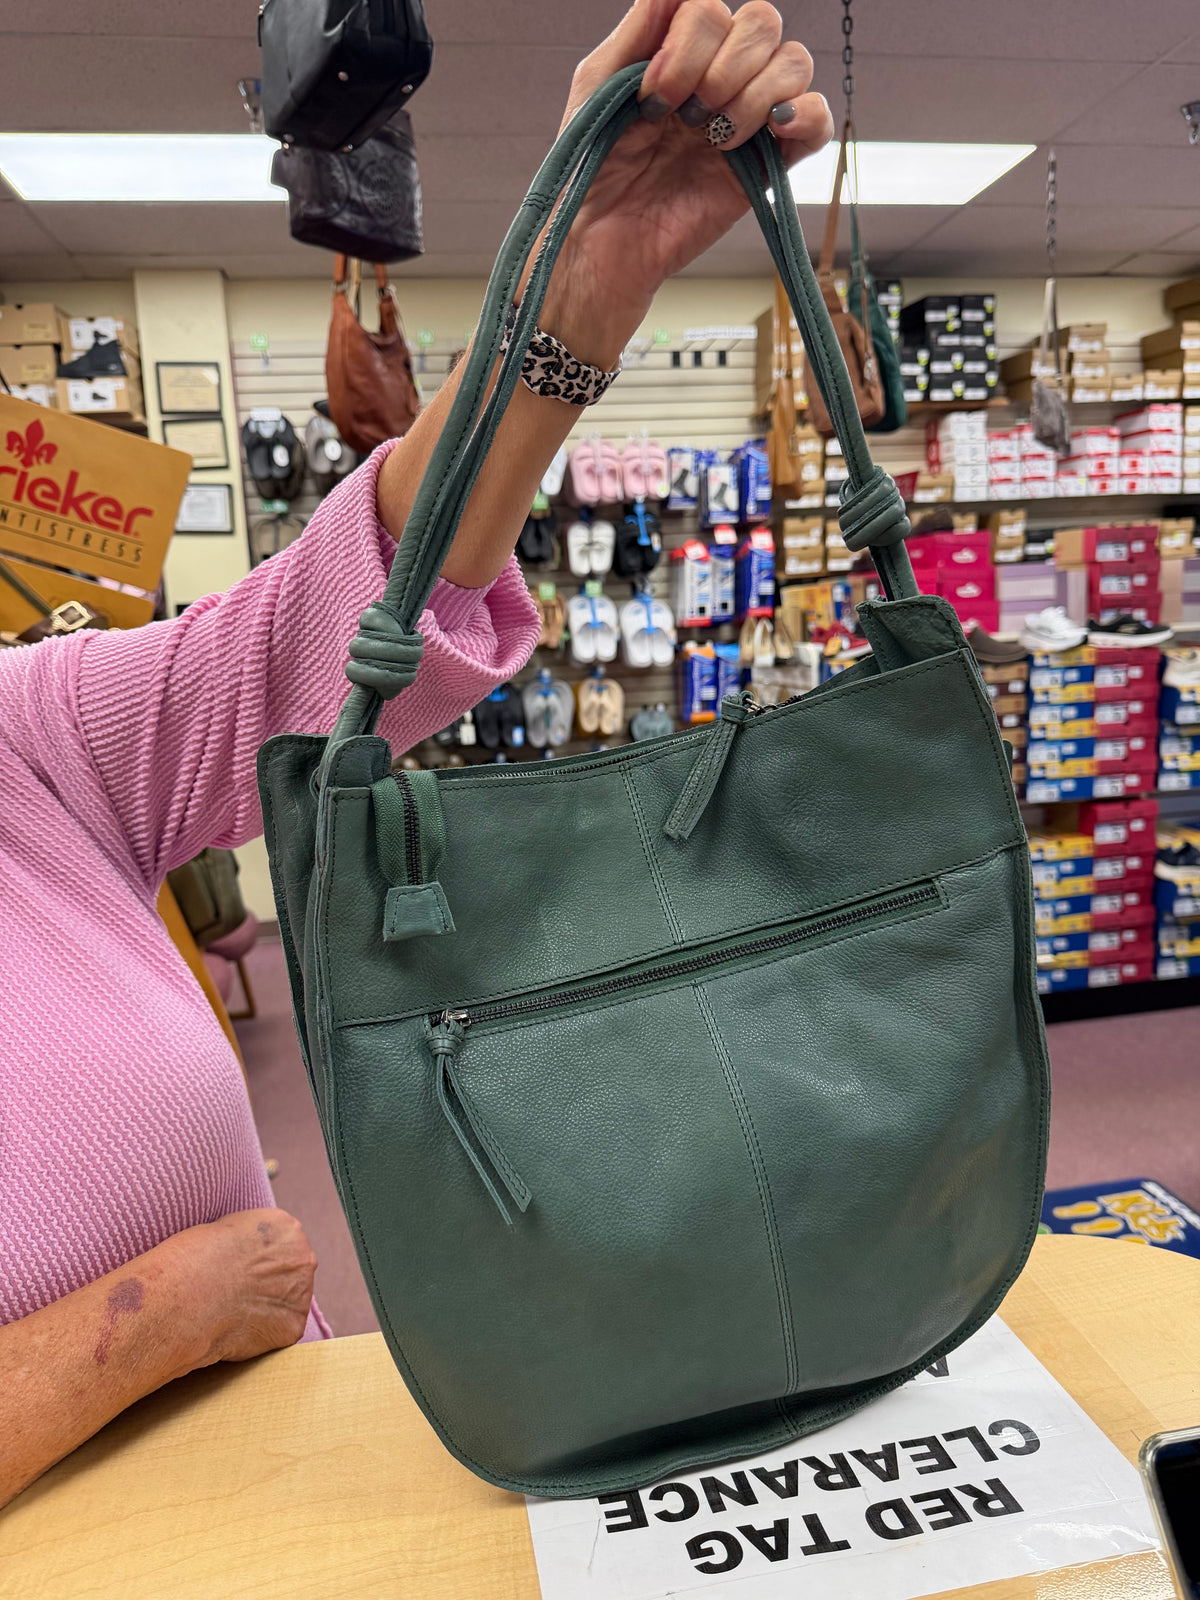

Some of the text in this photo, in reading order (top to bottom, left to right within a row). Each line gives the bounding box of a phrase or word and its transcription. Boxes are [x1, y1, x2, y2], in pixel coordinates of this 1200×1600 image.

[597, 1419, 1041, 1533] CLEARANCE
[685, 1477, 1024, 1575] RED TAG
